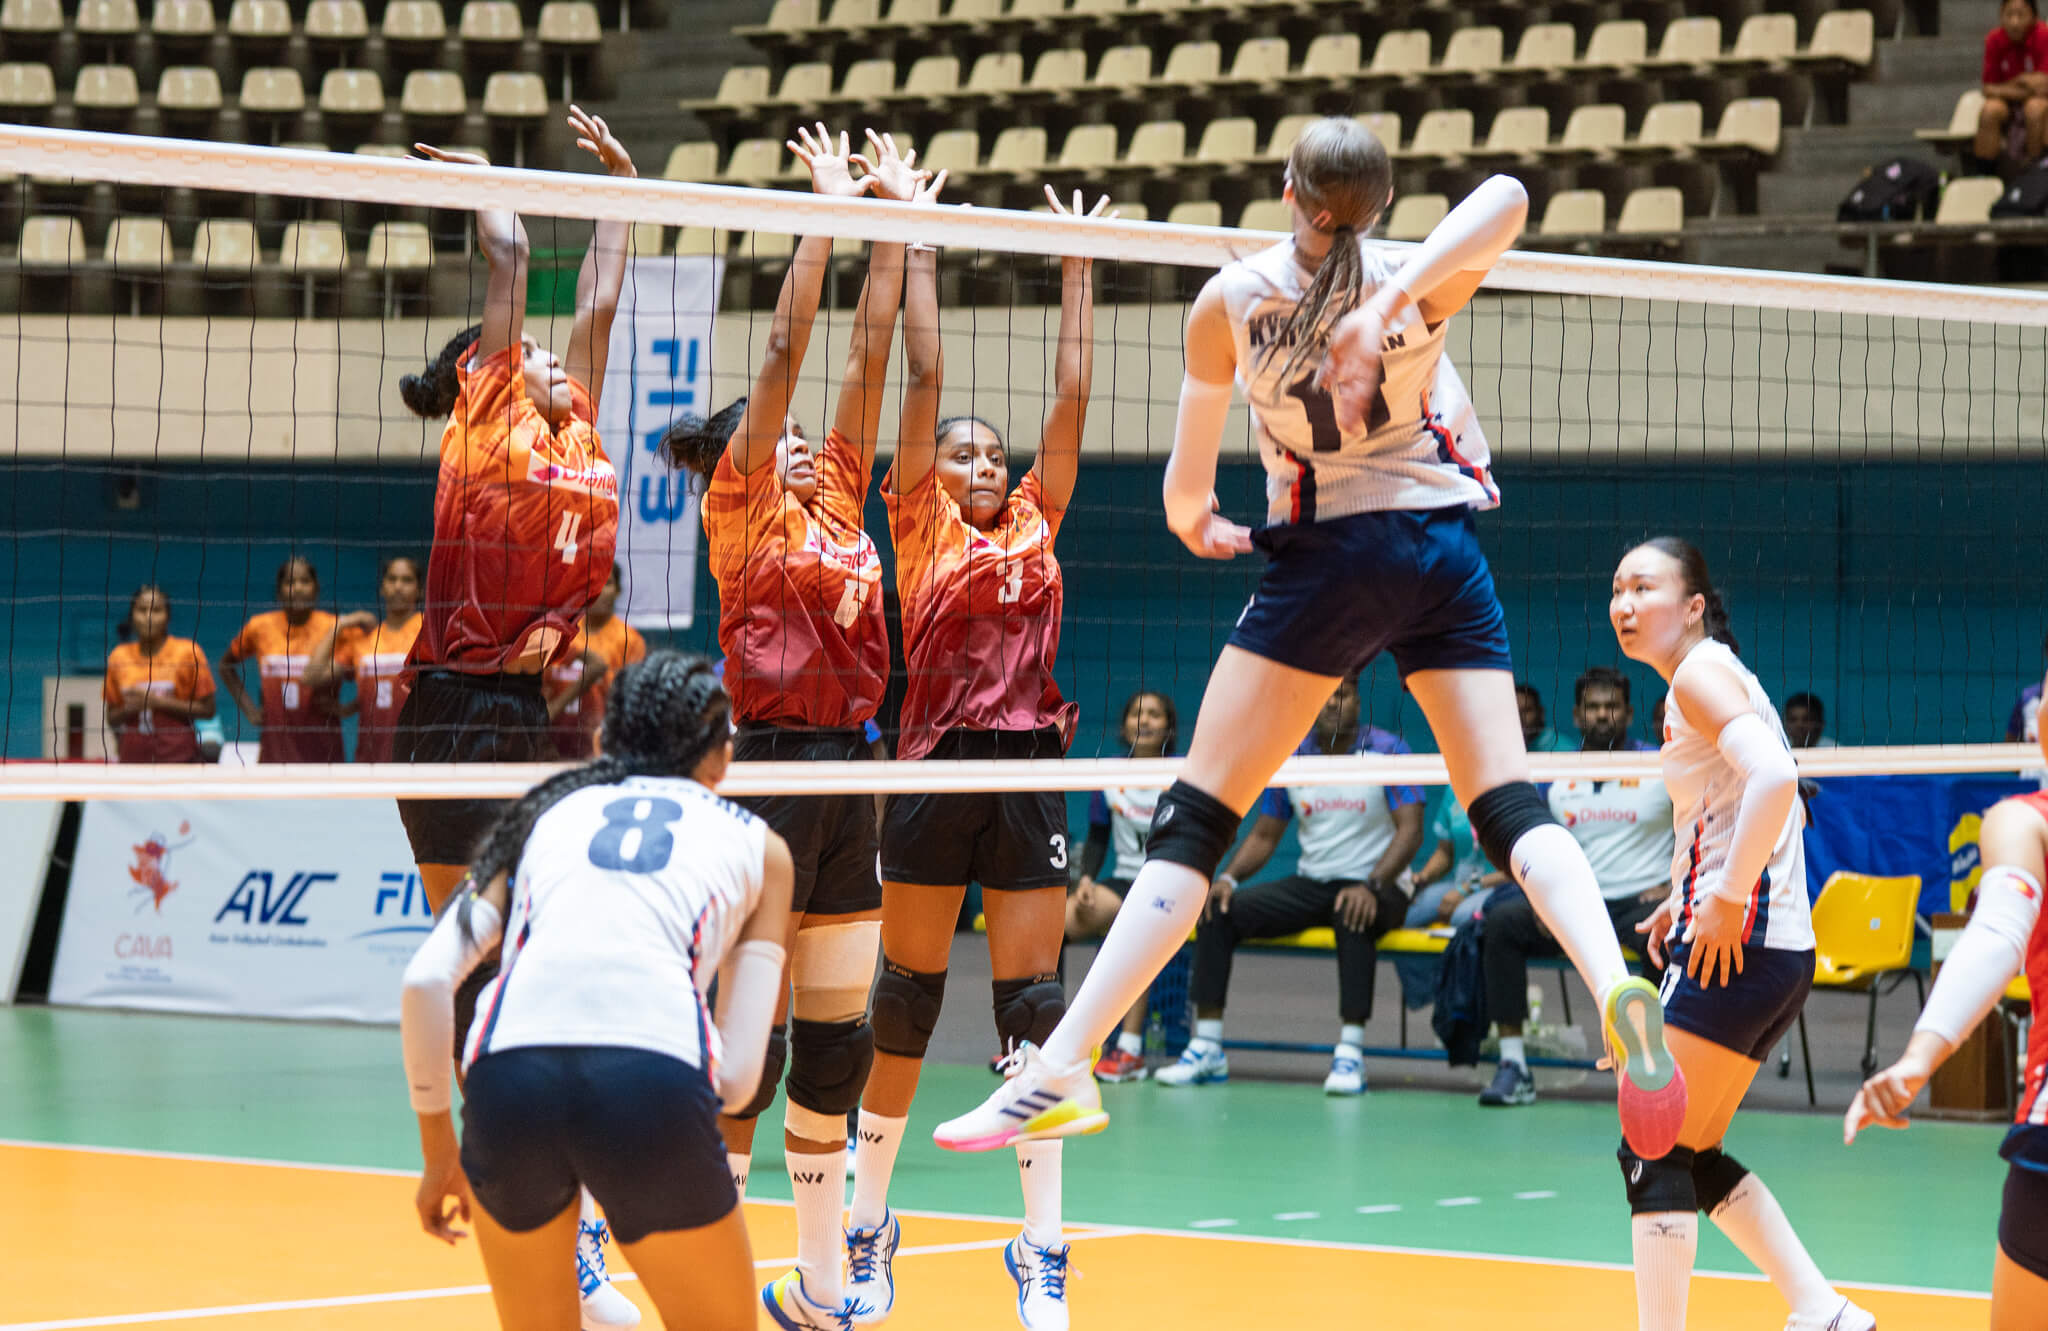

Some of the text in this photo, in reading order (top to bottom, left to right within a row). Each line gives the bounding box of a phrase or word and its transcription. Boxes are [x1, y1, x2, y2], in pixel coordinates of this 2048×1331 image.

[553, 510, 583, 564] 4
[996, 558, 1024, 604] 3
[588, 797, 684, 874] 8
[1579, 807, 1638, 824] Dialog
[1049, 833, 1068, 869] 3
[213, 869, 340, 926] AVC
[114, 933, 174, 960] CAVA
